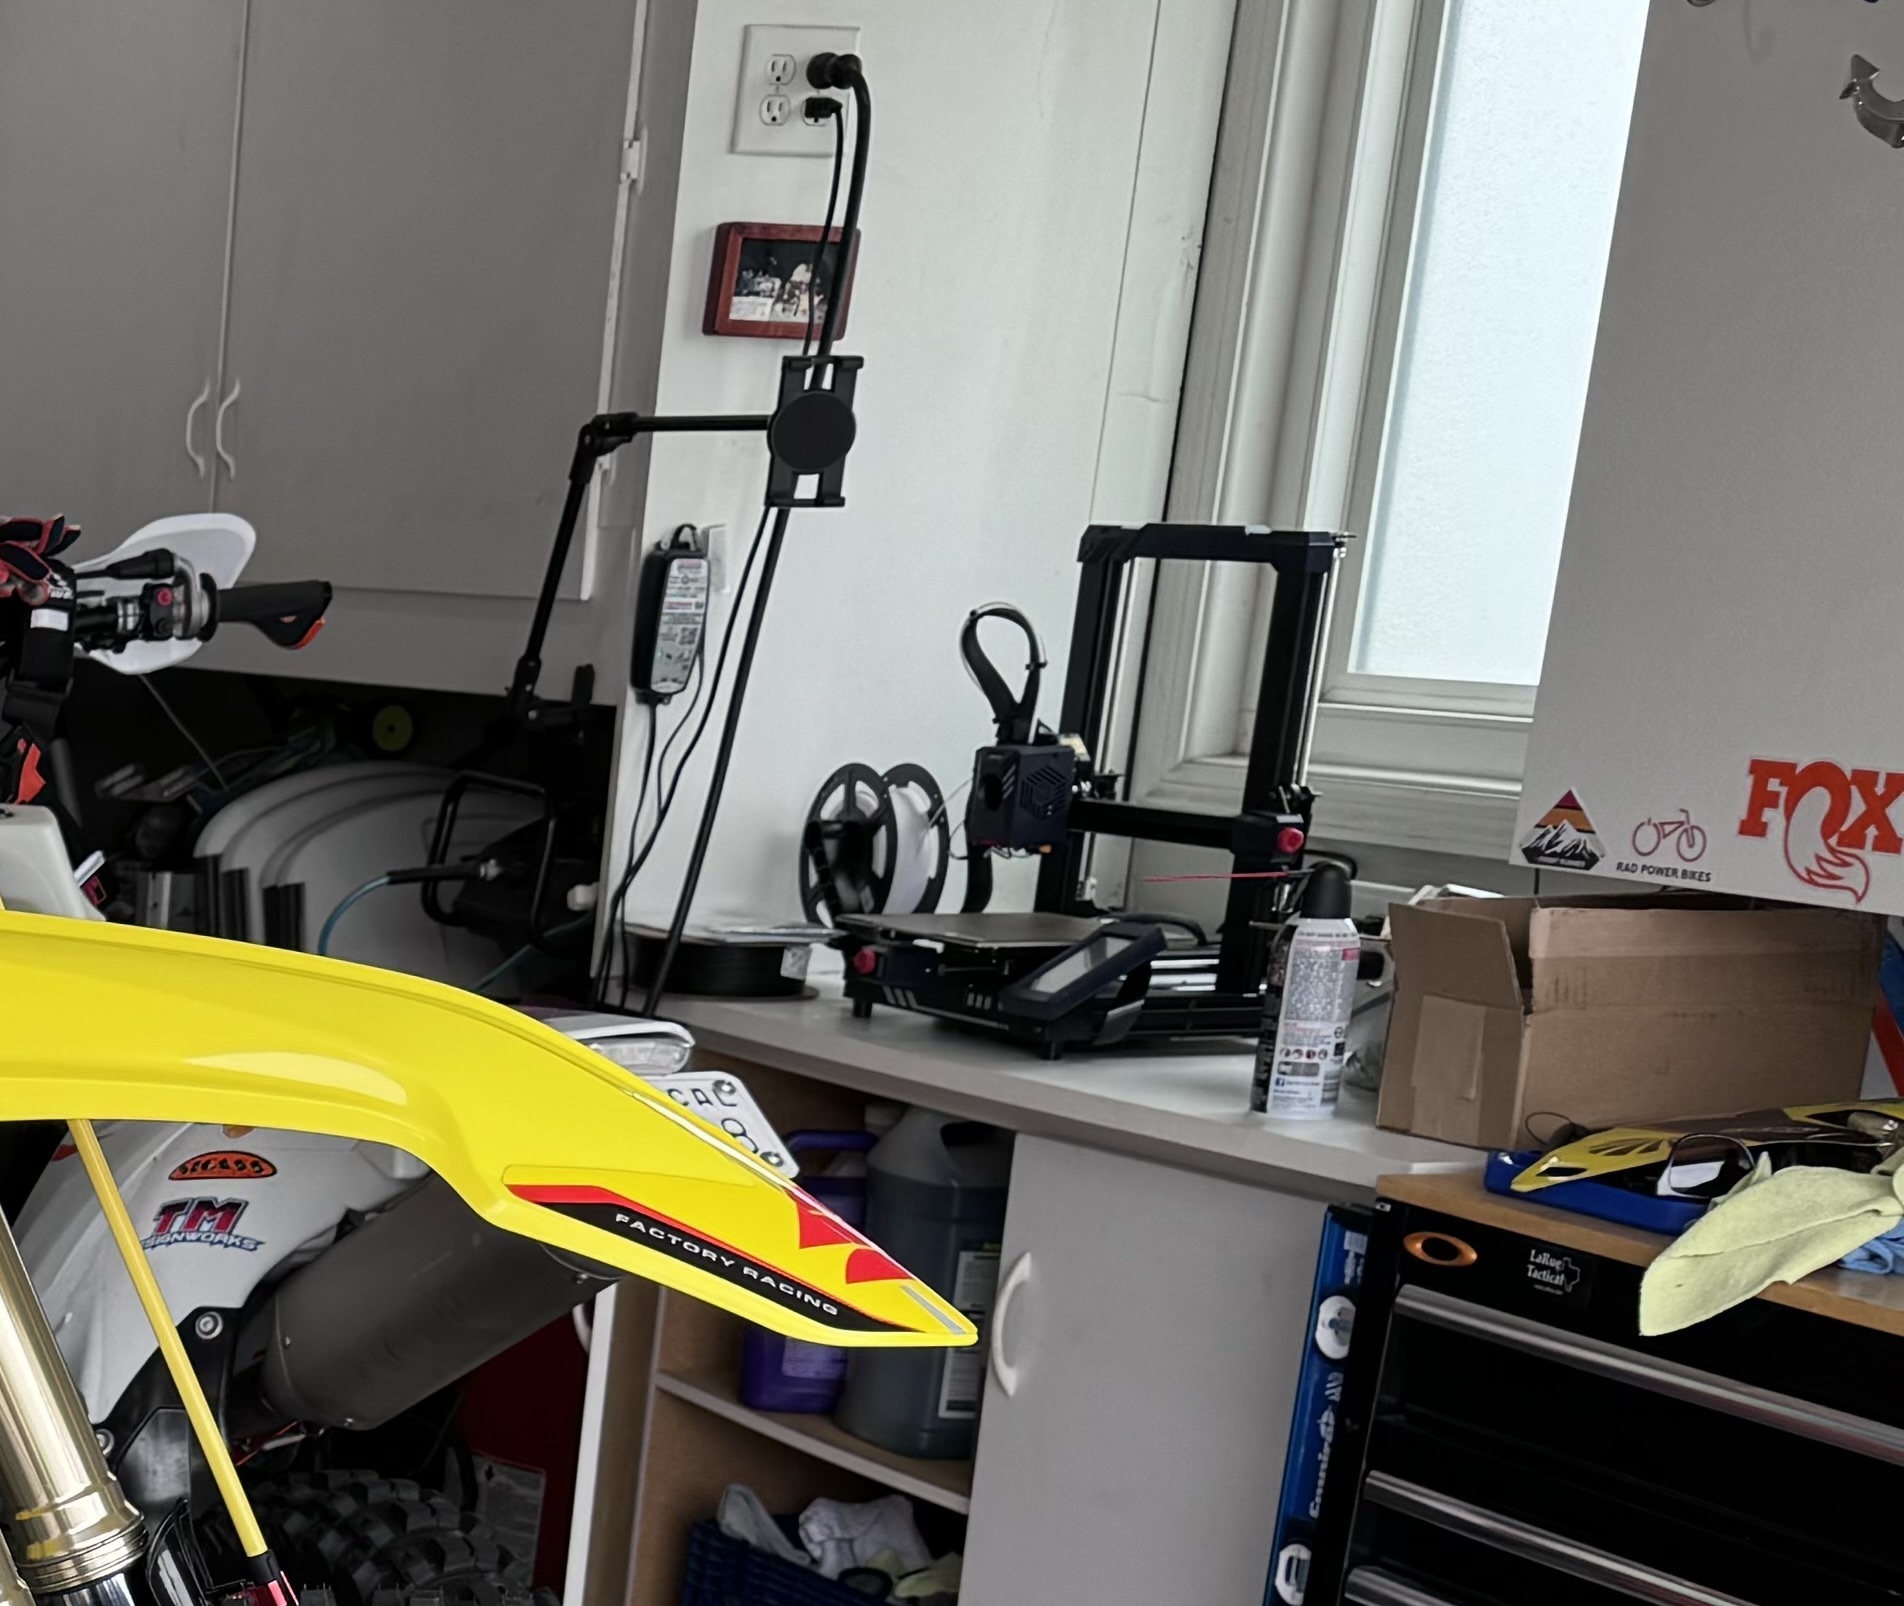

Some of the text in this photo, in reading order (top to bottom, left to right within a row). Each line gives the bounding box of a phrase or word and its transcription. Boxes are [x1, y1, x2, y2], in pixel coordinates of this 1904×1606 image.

[1739, 759, 1904, 854] FOX
[1616, 862, 1712, 883] RAD POWER BIKES
[154, 1199, 247, 1237] TM
[616, 1212, 839, 1316] FACTORY RACING
